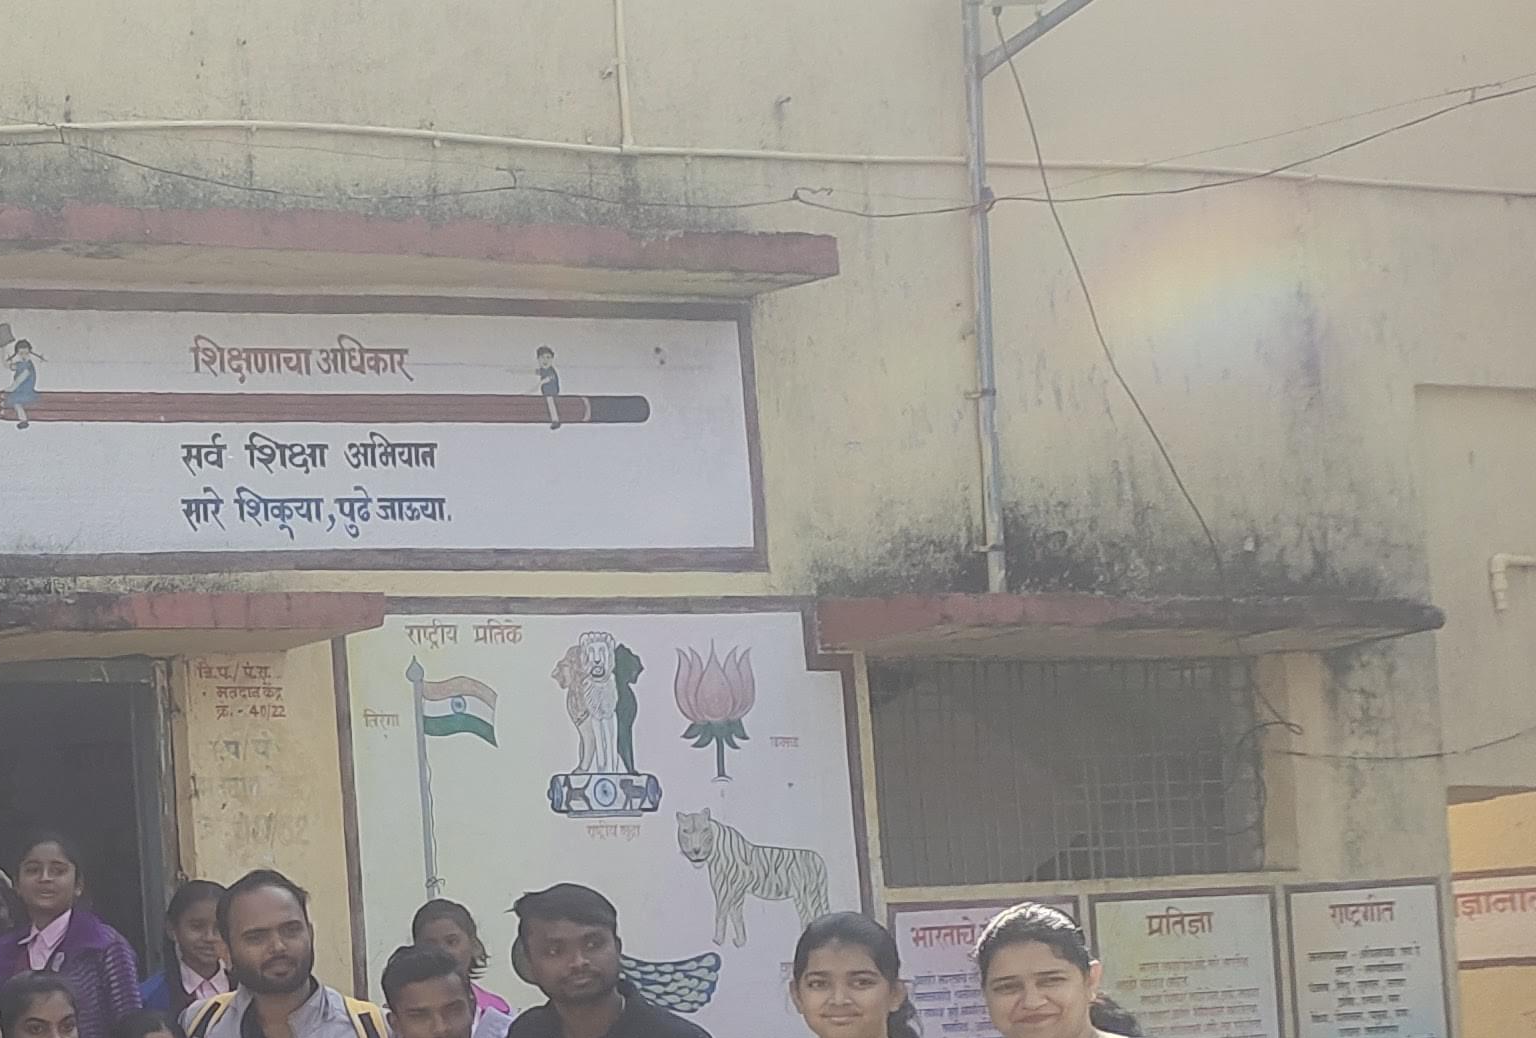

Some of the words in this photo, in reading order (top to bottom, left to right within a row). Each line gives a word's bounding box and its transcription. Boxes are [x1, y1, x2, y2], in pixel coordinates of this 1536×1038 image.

[189, 334, 312, 384] शिक्षणाचा
[316, 334, 413, 382] अधिकार
[181, 433, 227, 476] सर्व
[245, 432, 329, 474] शिक्षा
[181, 487, 225, 532] सारे
[405, 622, 458, 649] राष्ट्रीय
[1146, 907, 1214, 938] प्रतिज्ञा
